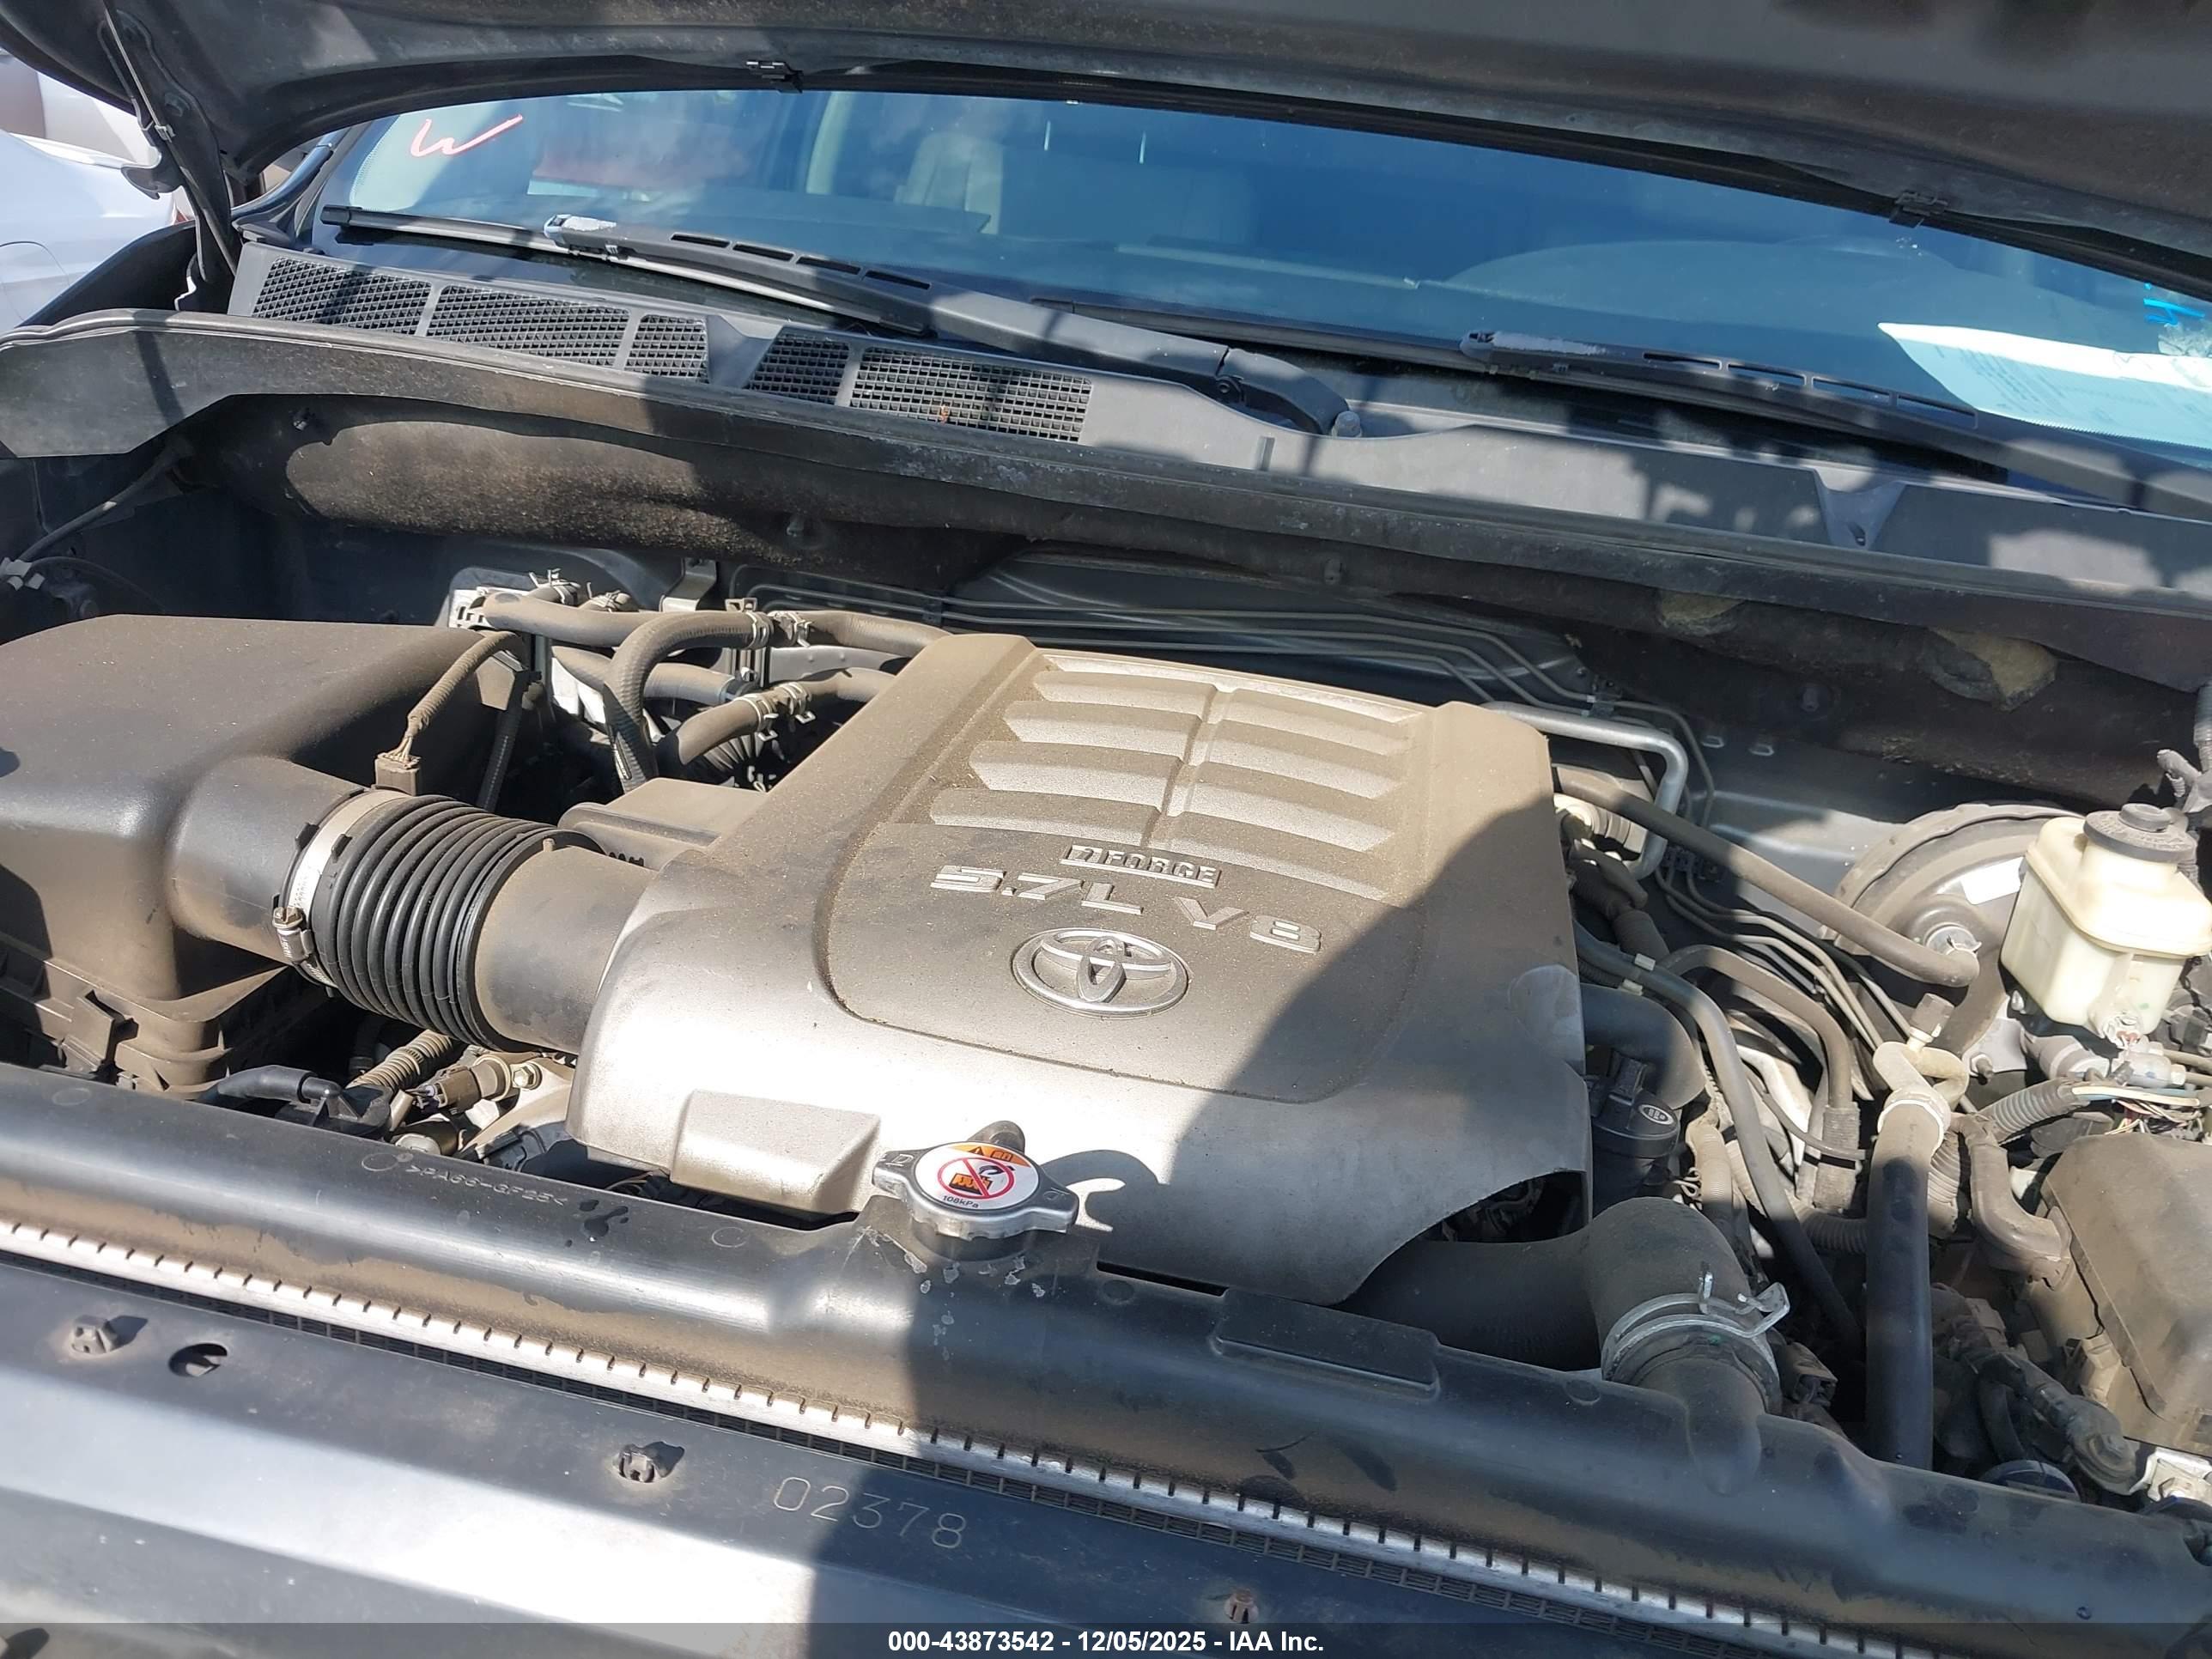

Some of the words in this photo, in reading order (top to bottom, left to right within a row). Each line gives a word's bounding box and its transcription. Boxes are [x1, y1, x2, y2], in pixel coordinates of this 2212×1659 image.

[930, 865, 1144, 915] 5.7L
[1174, 896, 1322, 954] V8
[943, 1194, 980, 1209] 108kPa
[774, 1476, 967, 1549] 02378
